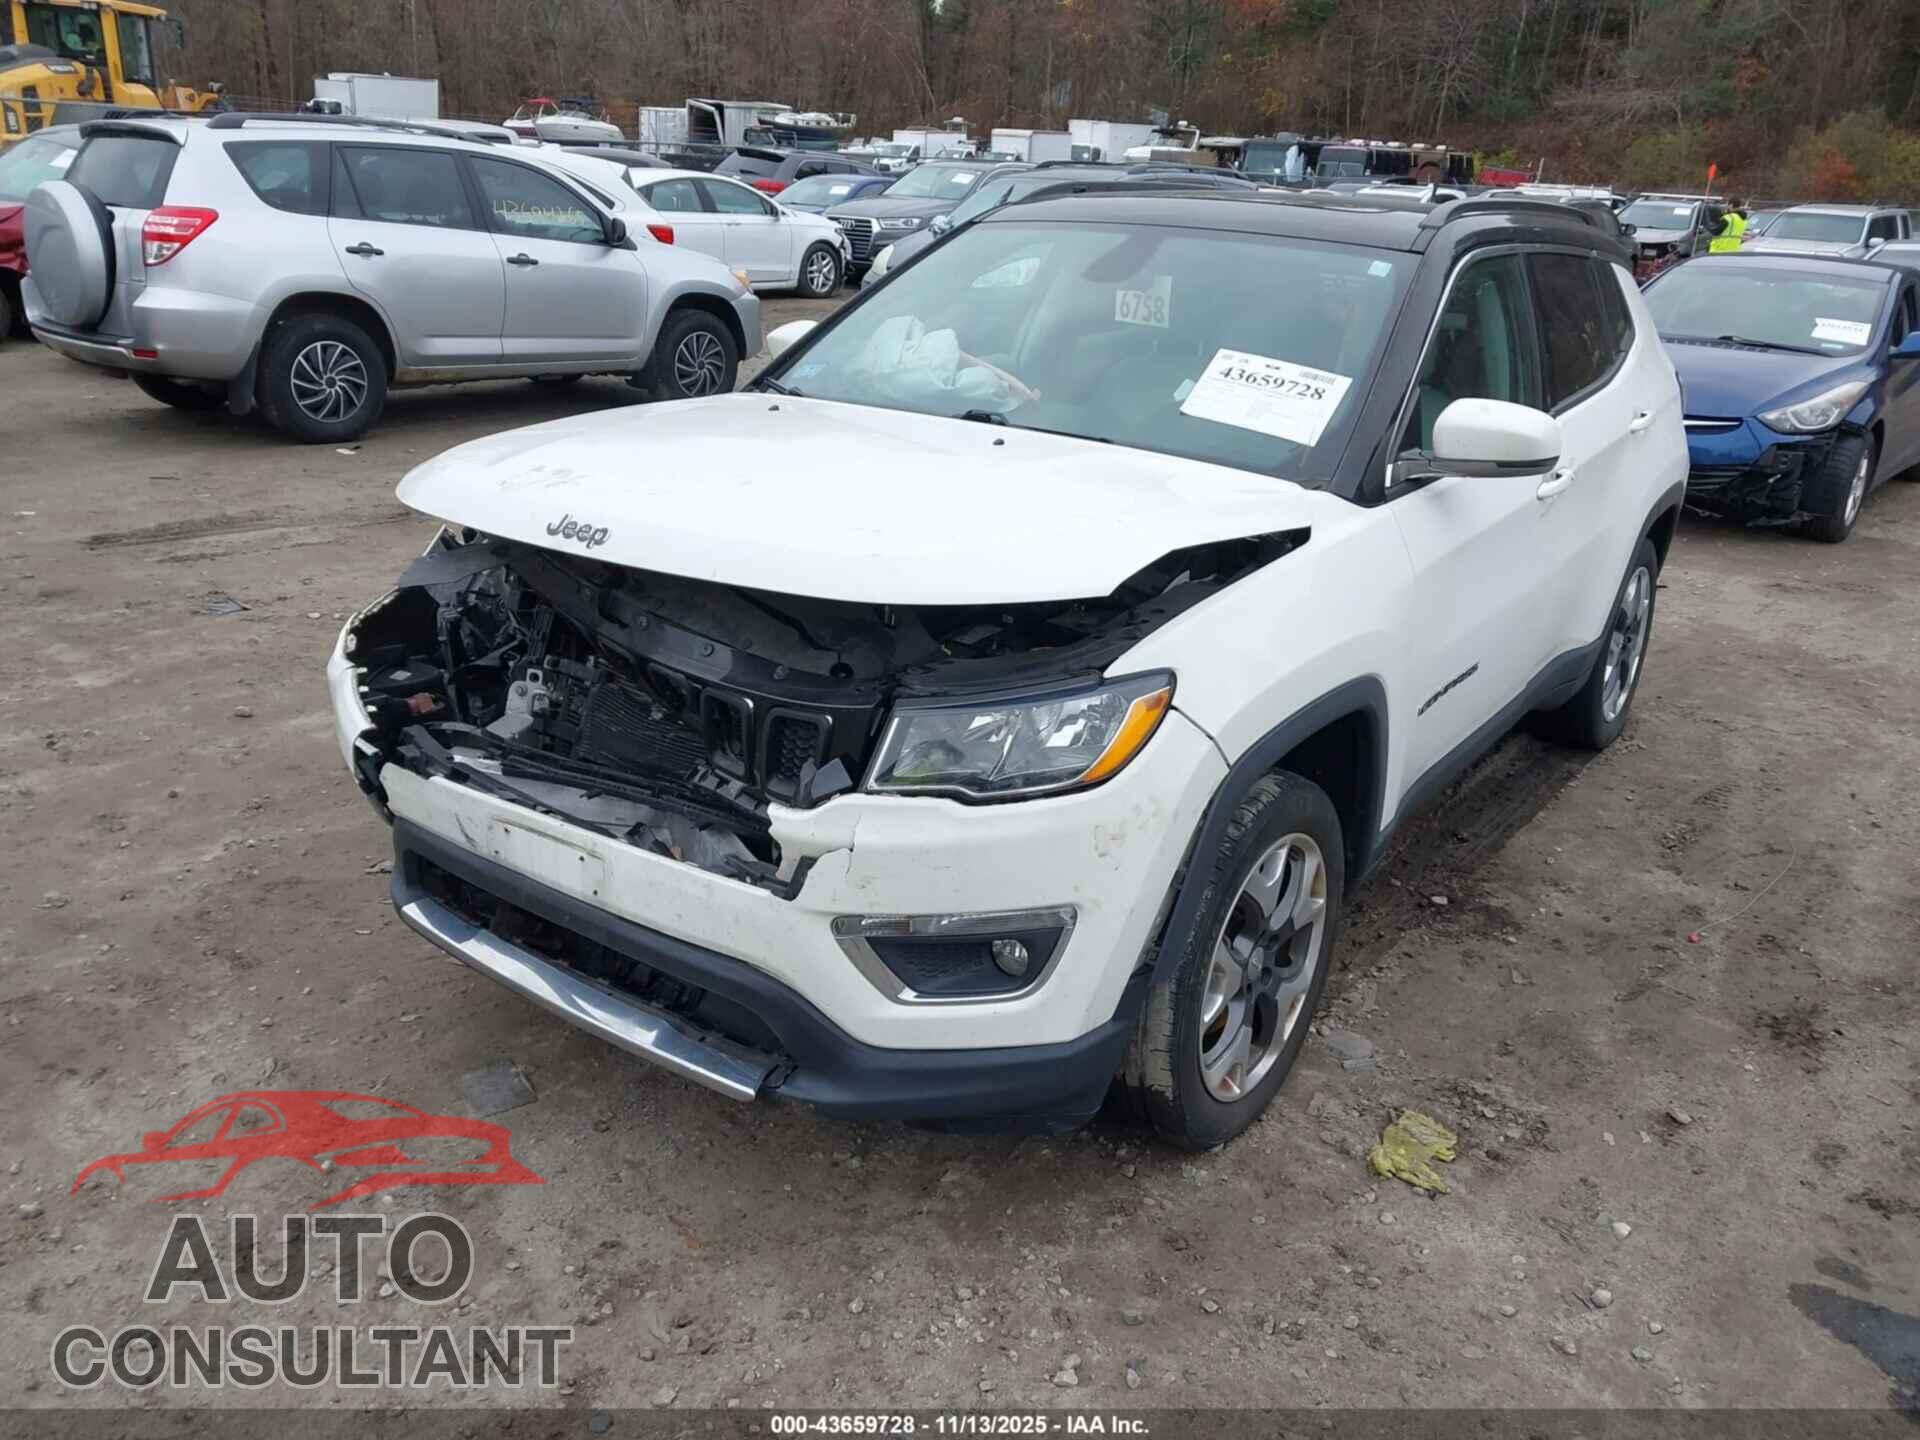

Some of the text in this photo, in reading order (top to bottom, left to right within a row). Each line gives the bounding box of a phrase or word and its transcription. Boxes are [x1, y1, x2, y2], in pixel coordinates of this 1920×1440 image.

[1119, 292, 1165, 324] 6758
[1219, 366, 1327, 401] 43659728
[546, 513, 609, 550] Jeep
